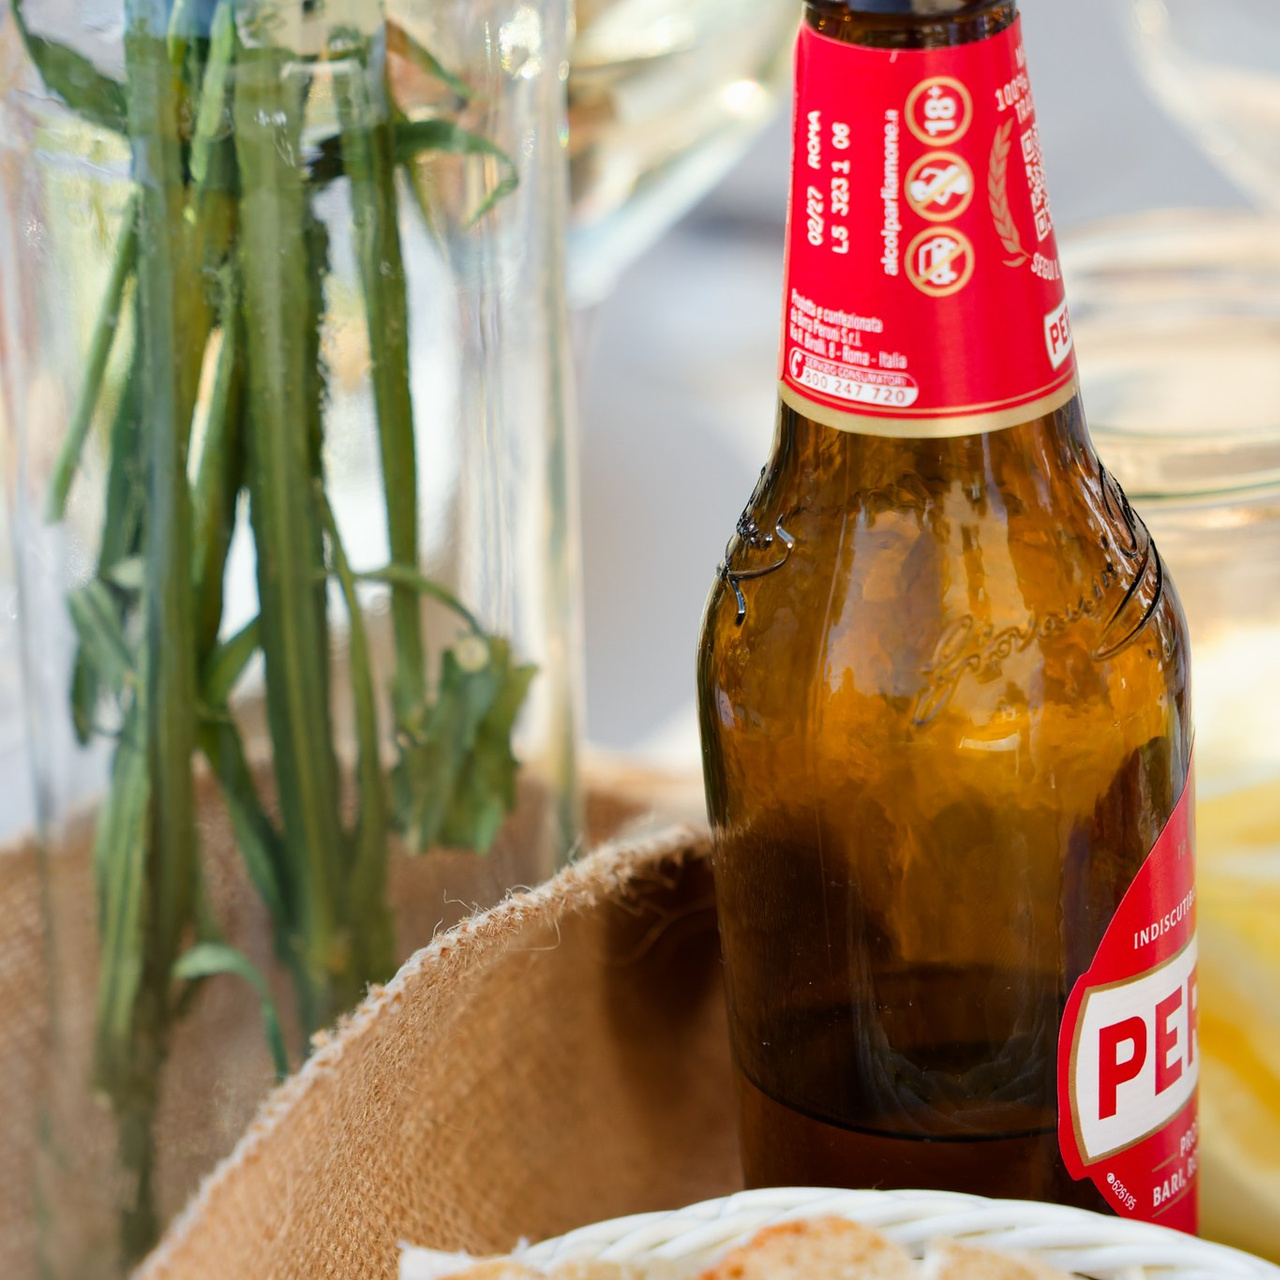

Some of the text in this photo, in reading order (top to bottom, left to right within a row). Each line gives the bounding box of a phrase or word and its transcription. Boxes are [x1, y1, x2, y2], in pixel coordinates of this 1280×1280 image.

[923, 85, 955, 137] 18+
[806, 110, 824, 247] 02/27 ROMA
[813, 318, 840, 343] Peroni
[823, 307, 884, 333] confezionata
[843, 345, 870, 366] Roma
[879, 351, 908, 369] Italia
[804, 370, 906, 404] 800 247 720
[1111, 1178, 1138, 1211] 626195
